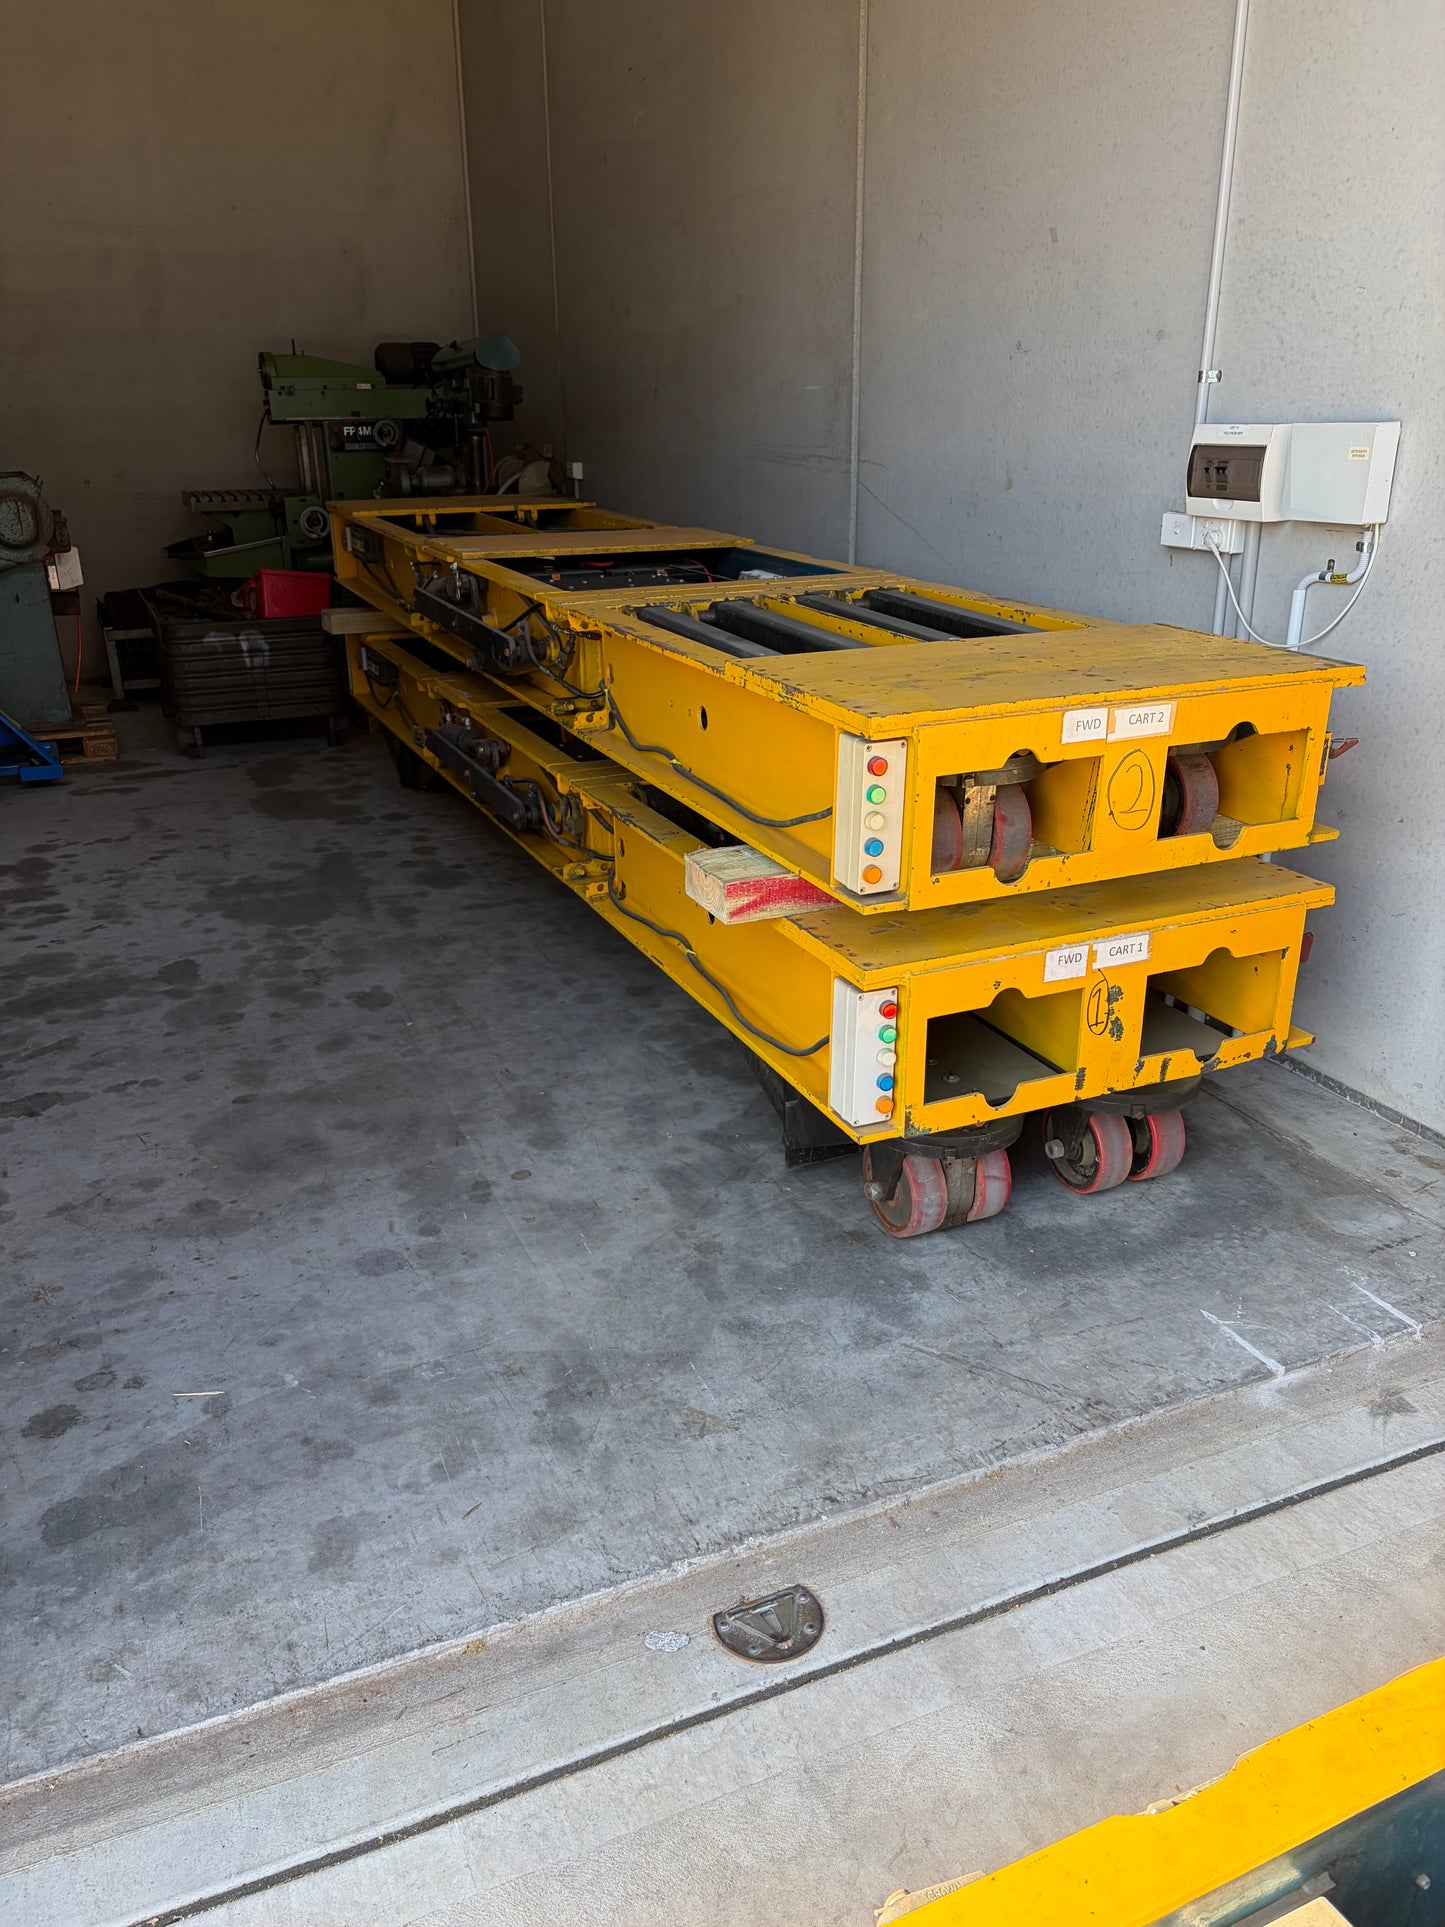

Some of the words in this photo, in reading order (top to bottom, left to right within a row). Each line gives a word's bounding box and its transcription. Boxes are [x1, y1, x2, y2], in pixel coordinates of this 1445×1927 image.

[1075, 718, 1102, 732] FWD
[1128, 713, 1156, 726] CART
[1157, 711, 1164, 723] 2
[1119, 764, 1148, 814] 2
[1108, 944, 1136, 957] CART
[1137, 942, 1143, 953] 1
[1057, 952, 1082, 966] FWD
[926, 1881, 964, 1902] CROWN
